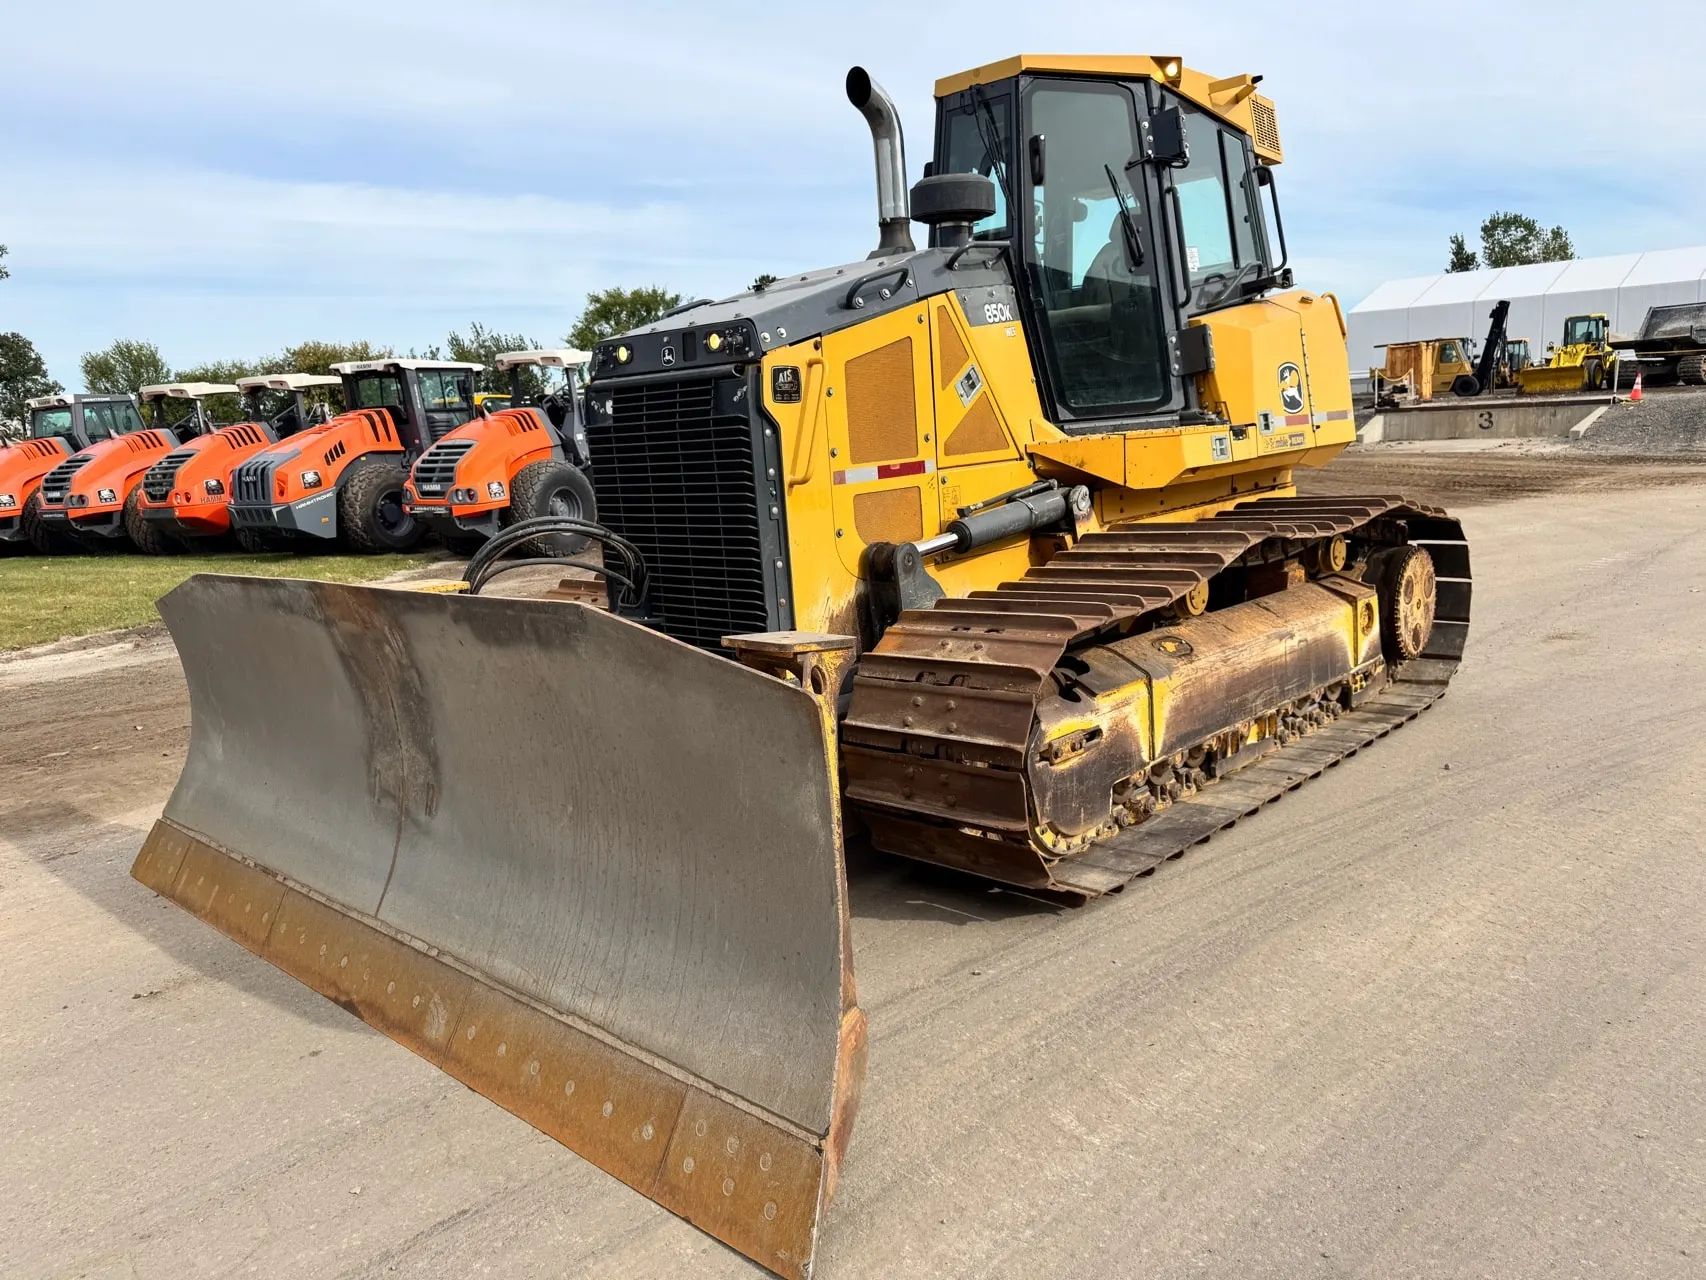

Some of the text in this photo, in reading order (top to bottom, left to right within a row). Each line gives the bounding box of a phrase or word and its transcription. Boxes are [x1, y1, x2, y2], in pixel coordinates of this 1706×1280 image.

[984, 302, 1013, 323] 850K
[1479, 411, 1494, 430] 3
[200, 495, 223, 504] HAMM
[295, 492, 334, 510] HAMMTRONIC
